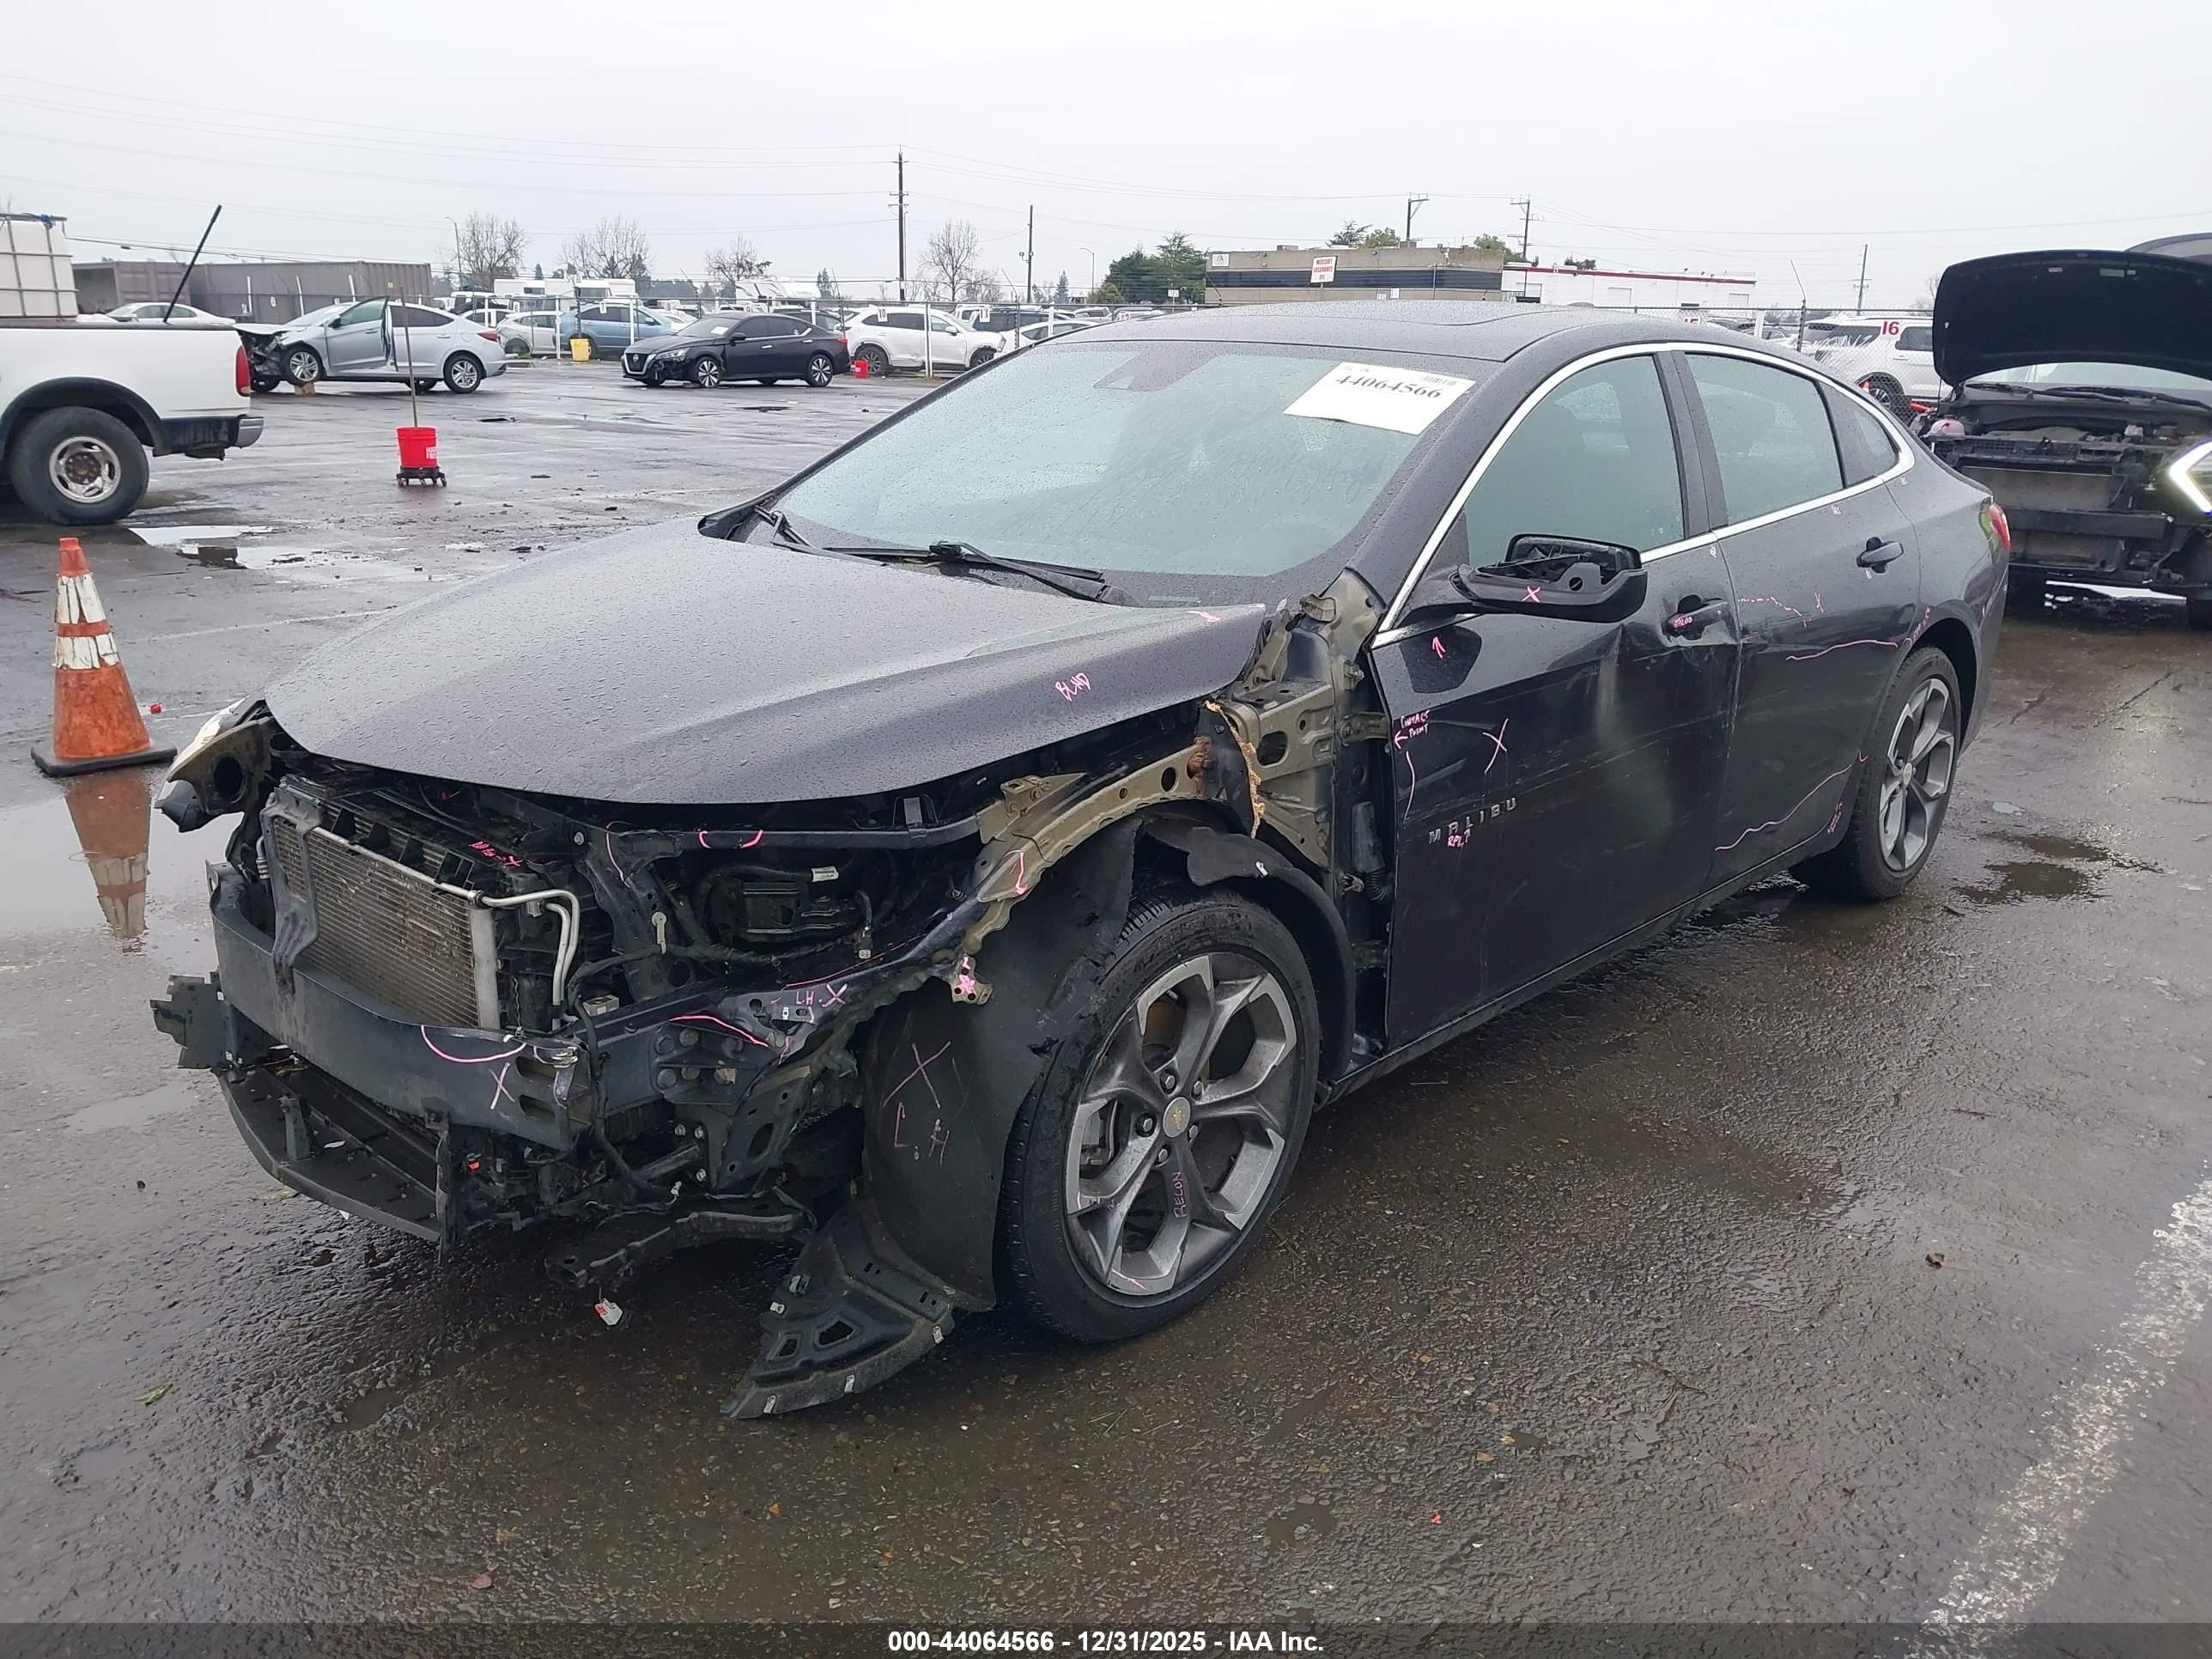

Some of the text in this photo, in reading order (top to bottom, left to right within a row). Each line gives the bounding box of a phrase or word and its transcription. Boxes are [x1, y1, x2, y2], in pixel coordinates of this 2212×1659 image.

[1881, 320, 1900, 336] 16
[1334, 374, 1444, 398] 44064566
[1428, 797, 1518, 845] MALIBU
[1170, 1170, 1188, 1218] RECON
